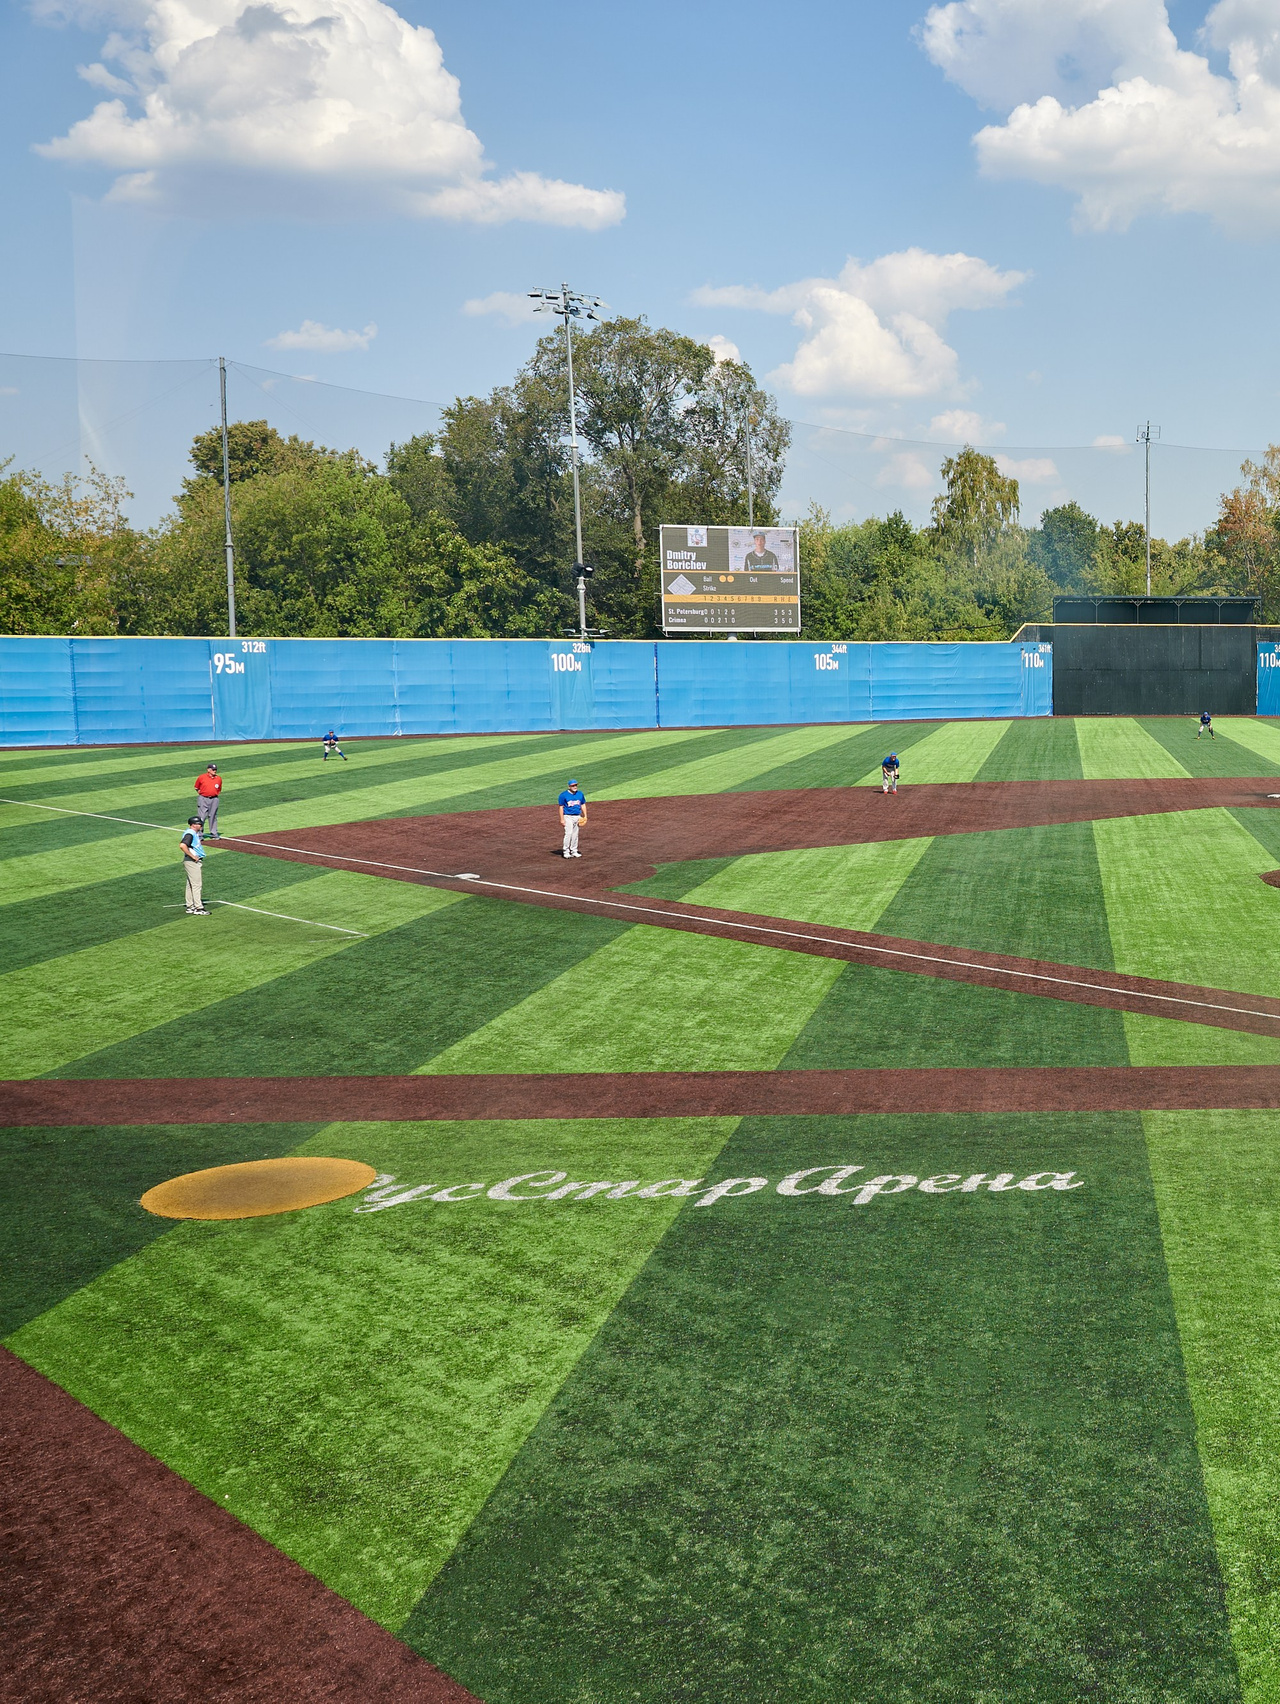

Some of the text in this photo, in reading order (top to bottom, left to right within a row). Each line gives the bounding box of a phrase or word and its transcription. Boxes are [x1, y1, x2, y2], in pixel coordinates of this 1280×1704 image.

[666, 550, 696, 560] Dmitry
[667, 560, 706, 569] Borichev
[241, 641, 266, 653] 312ft
[572, 642, 591, 653] 328ft
[831, 644, 847, 654] 344ft
[213, 653, 245, 674] 95M
[551, 653, 582, 672] 100M
[814, 653, 839, 670] 105M
[1024, 653, 1044, 668] 110M
[1260, 652, 1280, 668] 110M
